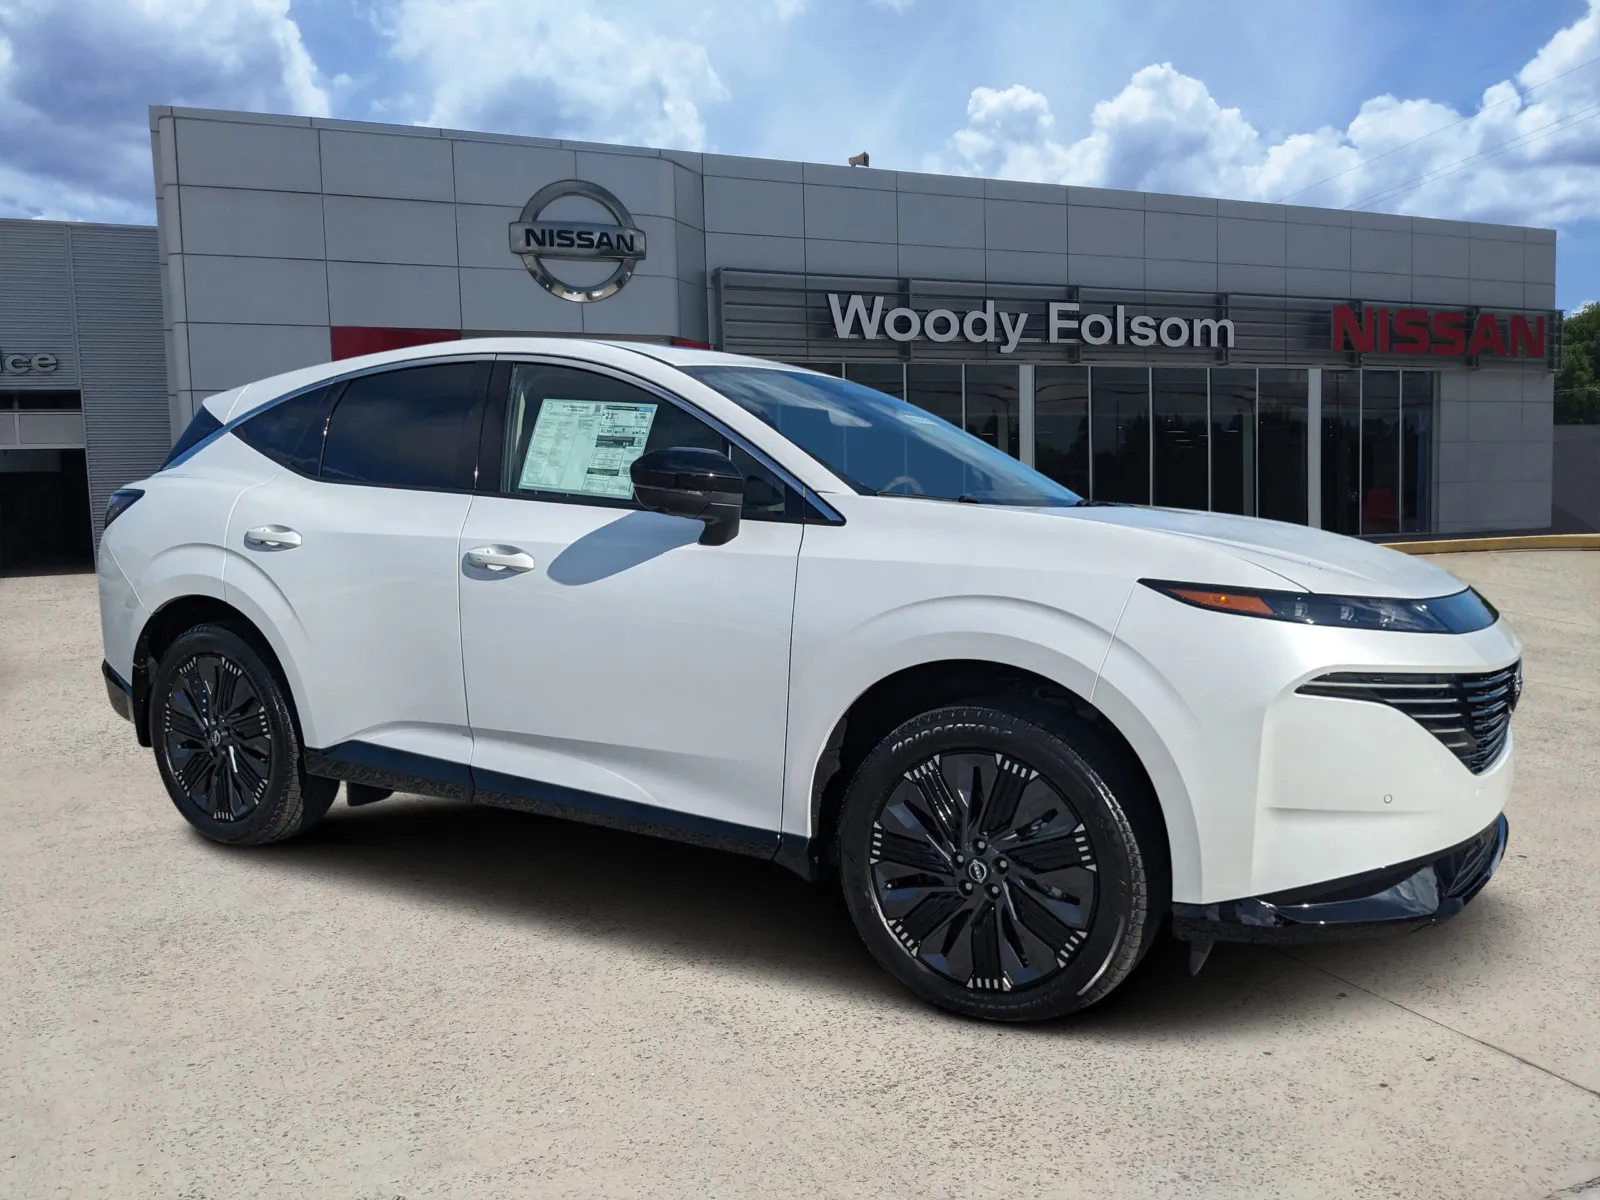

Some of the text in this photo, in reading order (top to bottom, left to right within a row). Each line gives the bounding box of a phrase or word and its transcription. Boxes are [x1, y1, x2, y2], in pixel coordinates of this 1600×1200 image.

[525, 228, 634, 252] NISSAN
[827, 293, 1236, 354] Woody Folsom
[1332, 305, 1545, 358] NISSAN
[0, 352, 58, 374] ce
